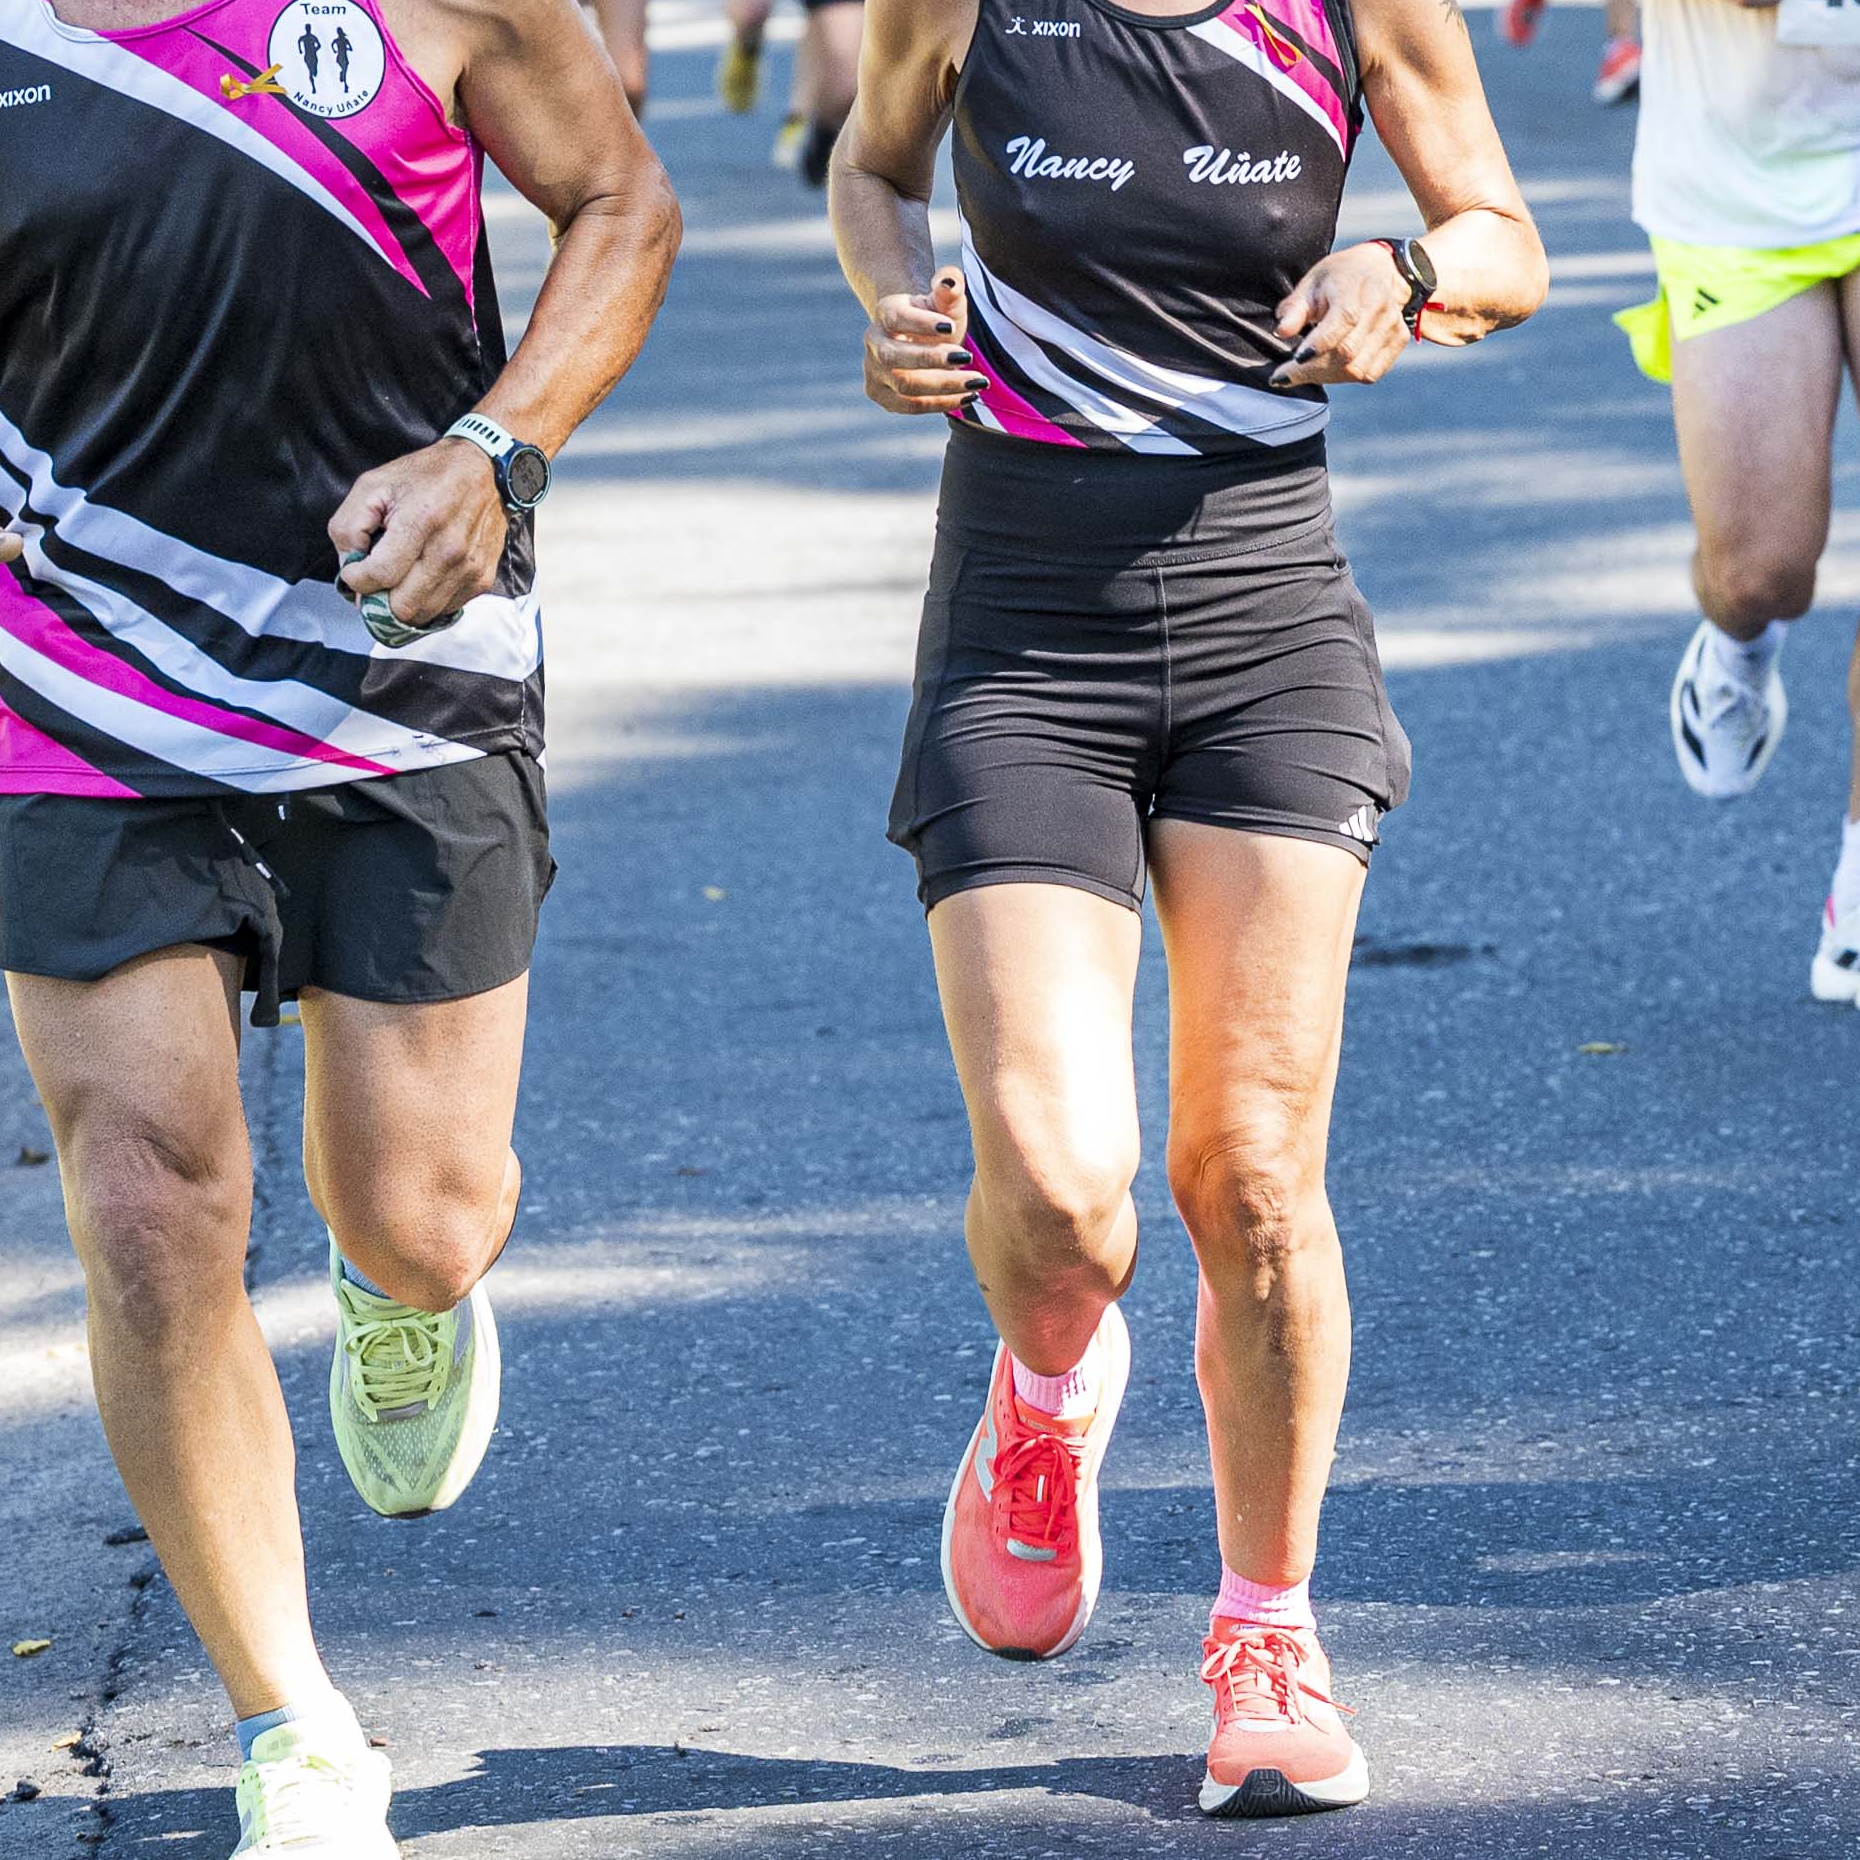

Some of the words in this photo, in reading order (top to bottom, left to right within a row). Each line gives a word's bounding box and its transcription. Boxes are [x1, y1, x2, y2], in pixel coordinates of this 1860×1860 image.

[300, 2, 347, 16] Team
[1031, 20, 1081, 38] xixon
[293, 91, 333, 116] Nancy
[1006, 136, 1135, 191] Nancy
[1183, 143, 1302, 185] Uñate
